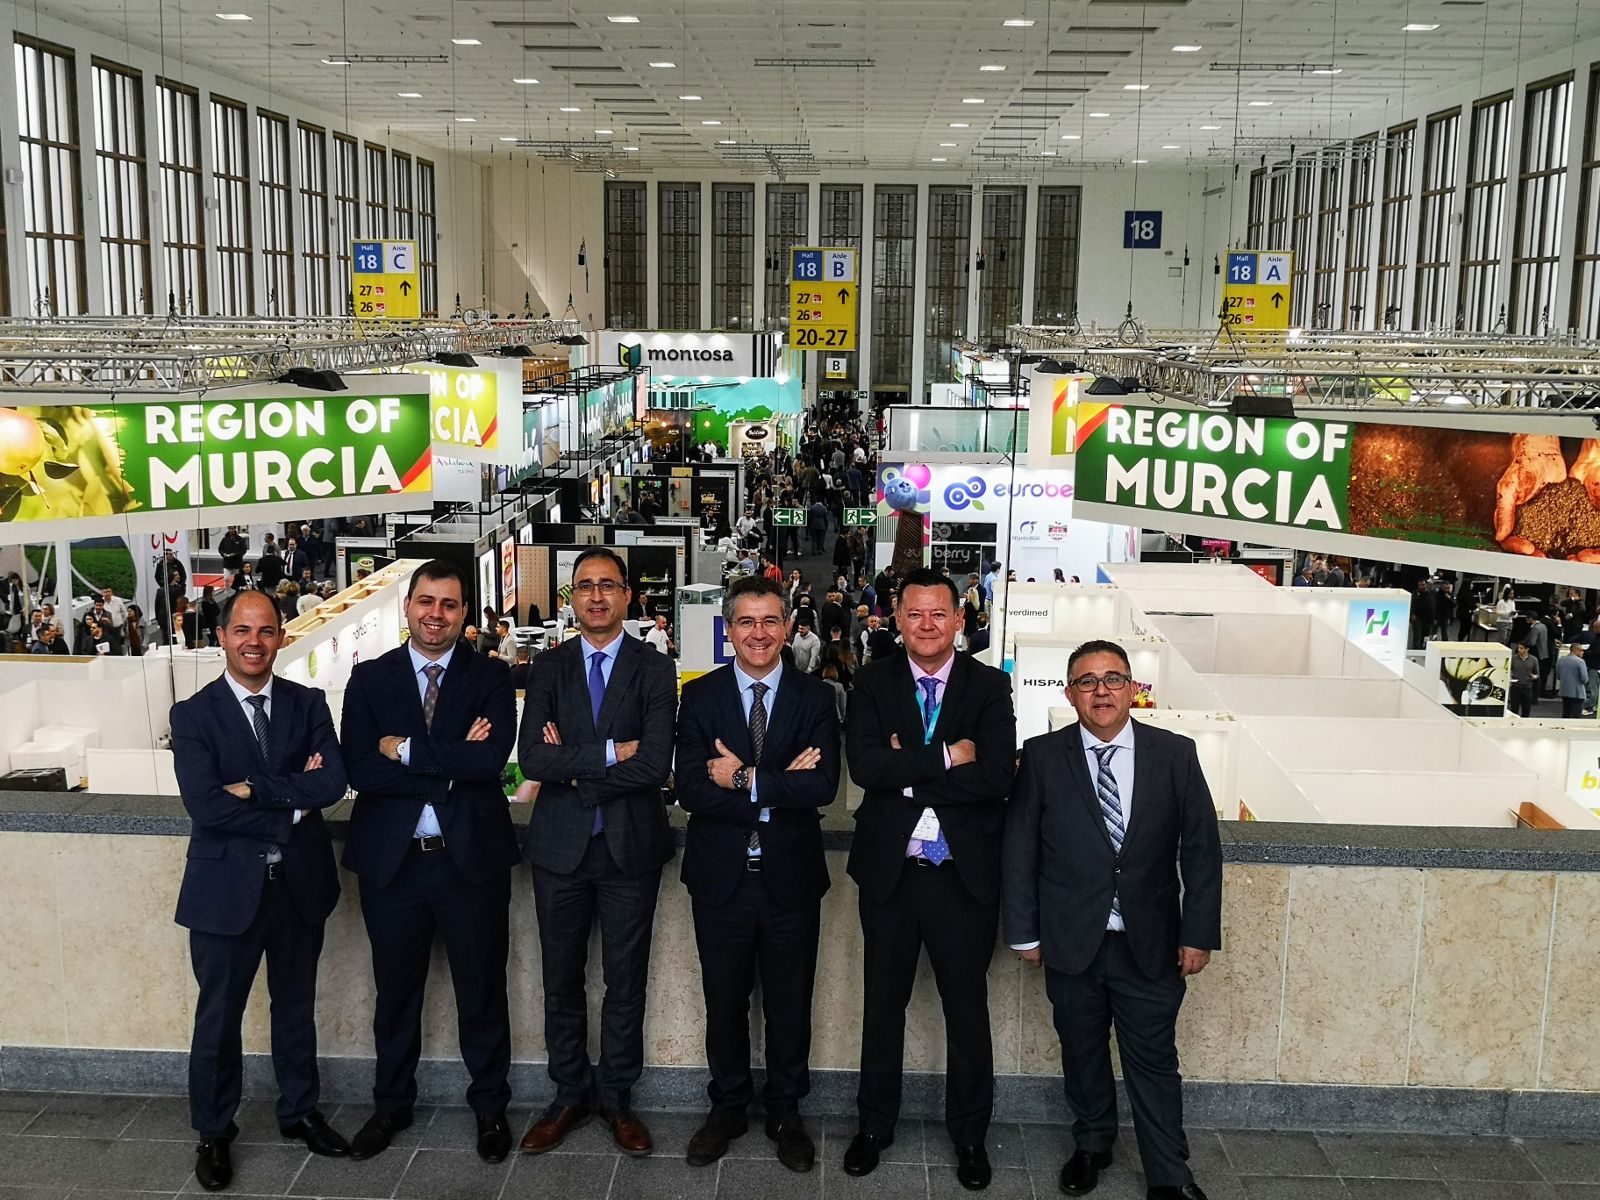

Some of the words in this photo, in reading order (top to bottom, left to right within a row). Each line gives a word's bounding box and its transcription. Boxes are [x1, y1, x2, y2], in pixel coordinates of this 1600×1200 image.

[1130, 220, 1155, 240] 18
[358, 254, 378, 270] 18
[393, 253, 406, 270] C
[797, 262, 817, 277] 18
[833, 261, 845, 278] B
[1231, 265, 1251, 281] 18
[1266, 264, 1282, 281] A
[359, 285, 373, 297] 27
[797, 293, 811, 304] 27
[360, 301, 373, 313] 26
[1229, 296, 1243, 308] 27
[796, 309, 810, 321] 26
[1228, 313, 1242, 325] 26
[796, 328, 848, 346] 20-27
[647, 348, 734, 362] montosa
[832, 360, 840, 371] B
[145, 400, 326, 444] REGION
[345, 398, 400, 434] OF
[1106, 407, 1266, 456] REGION
[1285, 421, 1349, 463] OF
[148, 444, 404, 509] MURCIA
[1105, 454, 1343, 530] MURCIA
[1008, 609, 1049, 617] verdimed
